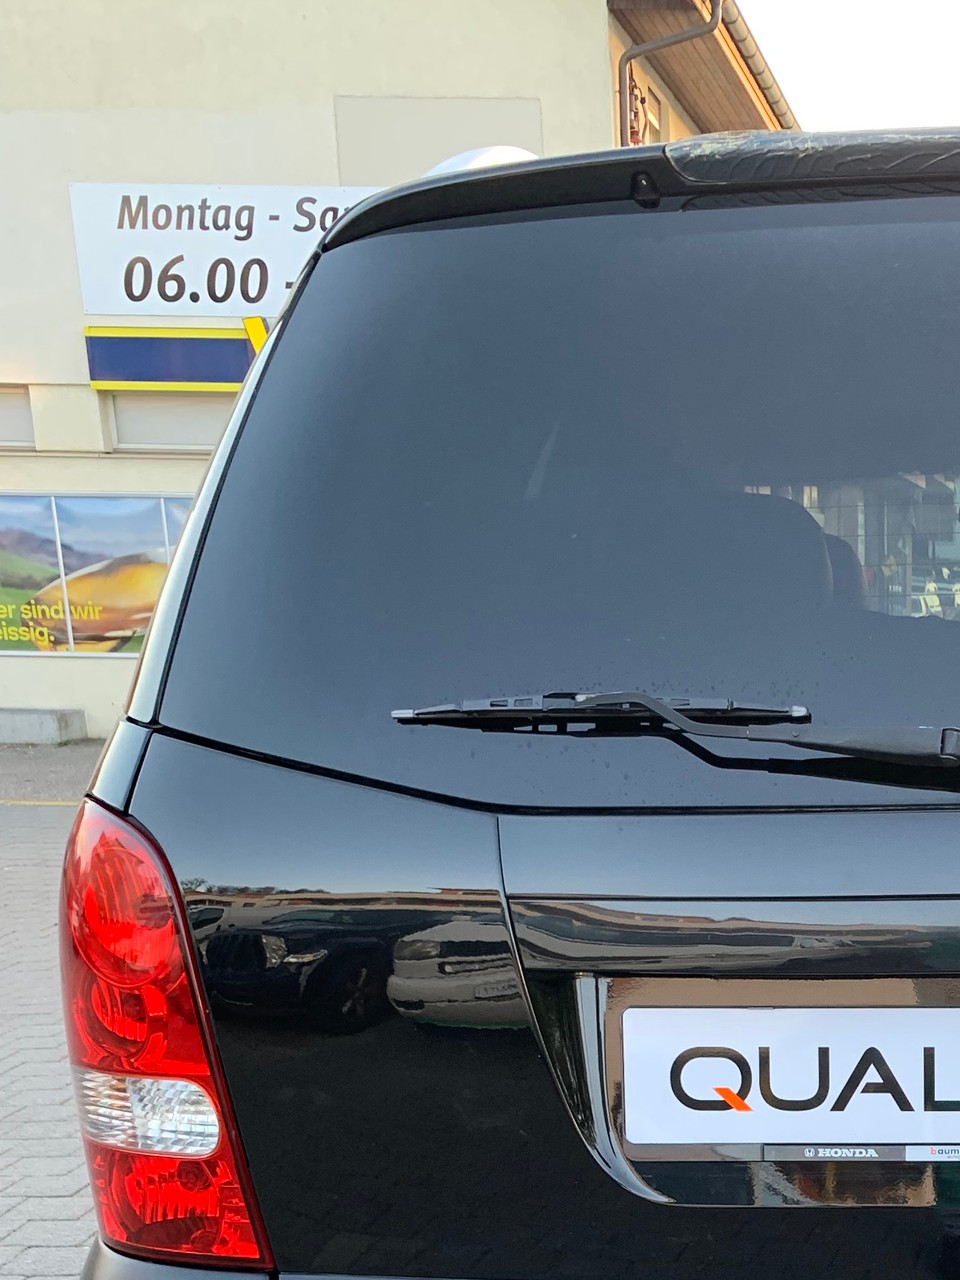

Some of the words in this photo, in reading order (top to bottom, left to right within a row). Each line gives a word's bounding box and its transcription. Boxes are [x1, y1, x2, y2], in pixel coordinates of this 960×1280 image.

[117, 195, 255, 241] Montag
[293, 196, 350, 232] Sa
[124, 254, 269, 304] 06.00
[20, 599, 64, 619] sind
[70, 601, 103, 620] wir
[0, 621, 55, 645] issig.
[817, 1148, 879, 1158] HONDA
